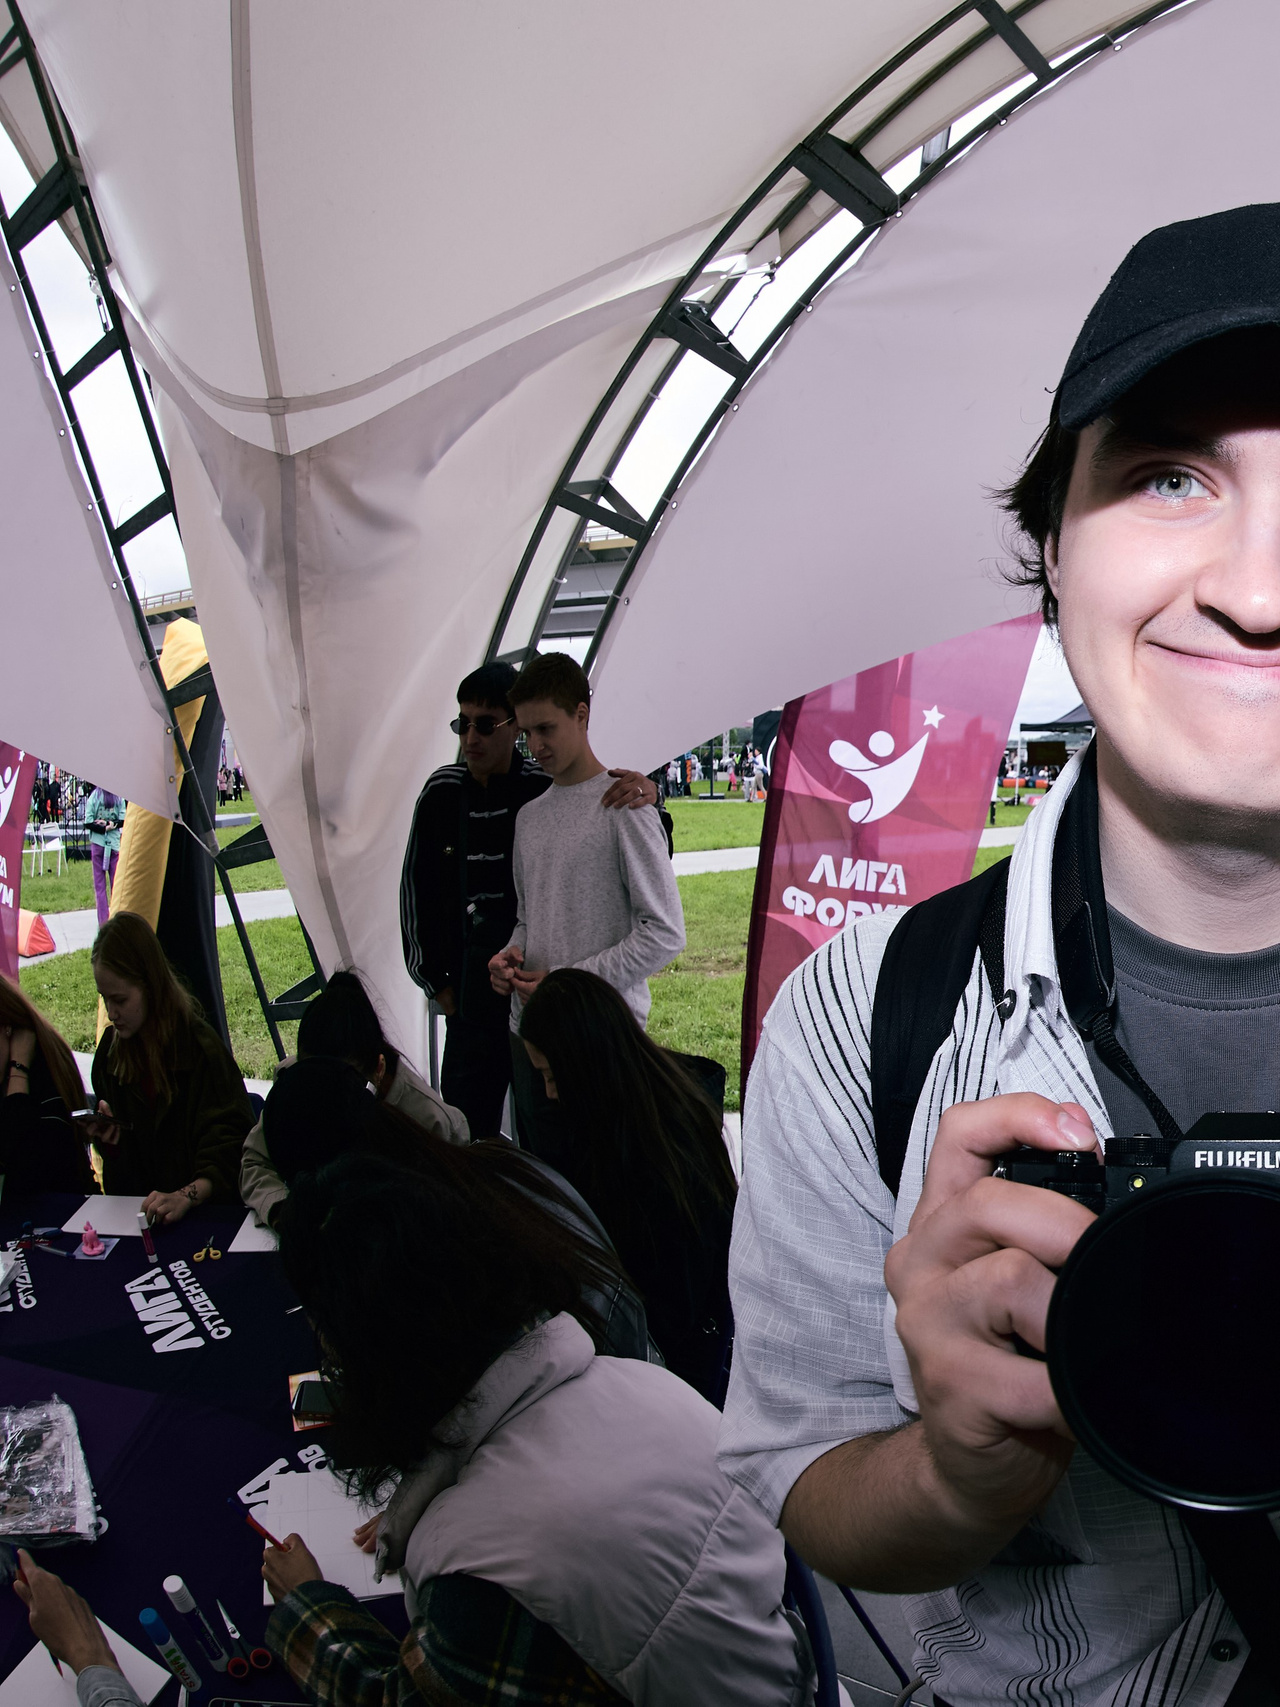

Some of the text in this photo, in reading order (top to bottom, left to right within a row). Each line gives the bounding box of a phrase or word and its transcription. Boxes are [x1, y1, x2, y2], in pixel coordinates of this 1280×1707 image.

[807, 853, 907, 895] ЛИГА
[782, 885, 912, 928] ФОР
[124, 1267, 206, 1353] ЛИГА
[168, 1260, 232, 1340] СТУДЕНТОВ
